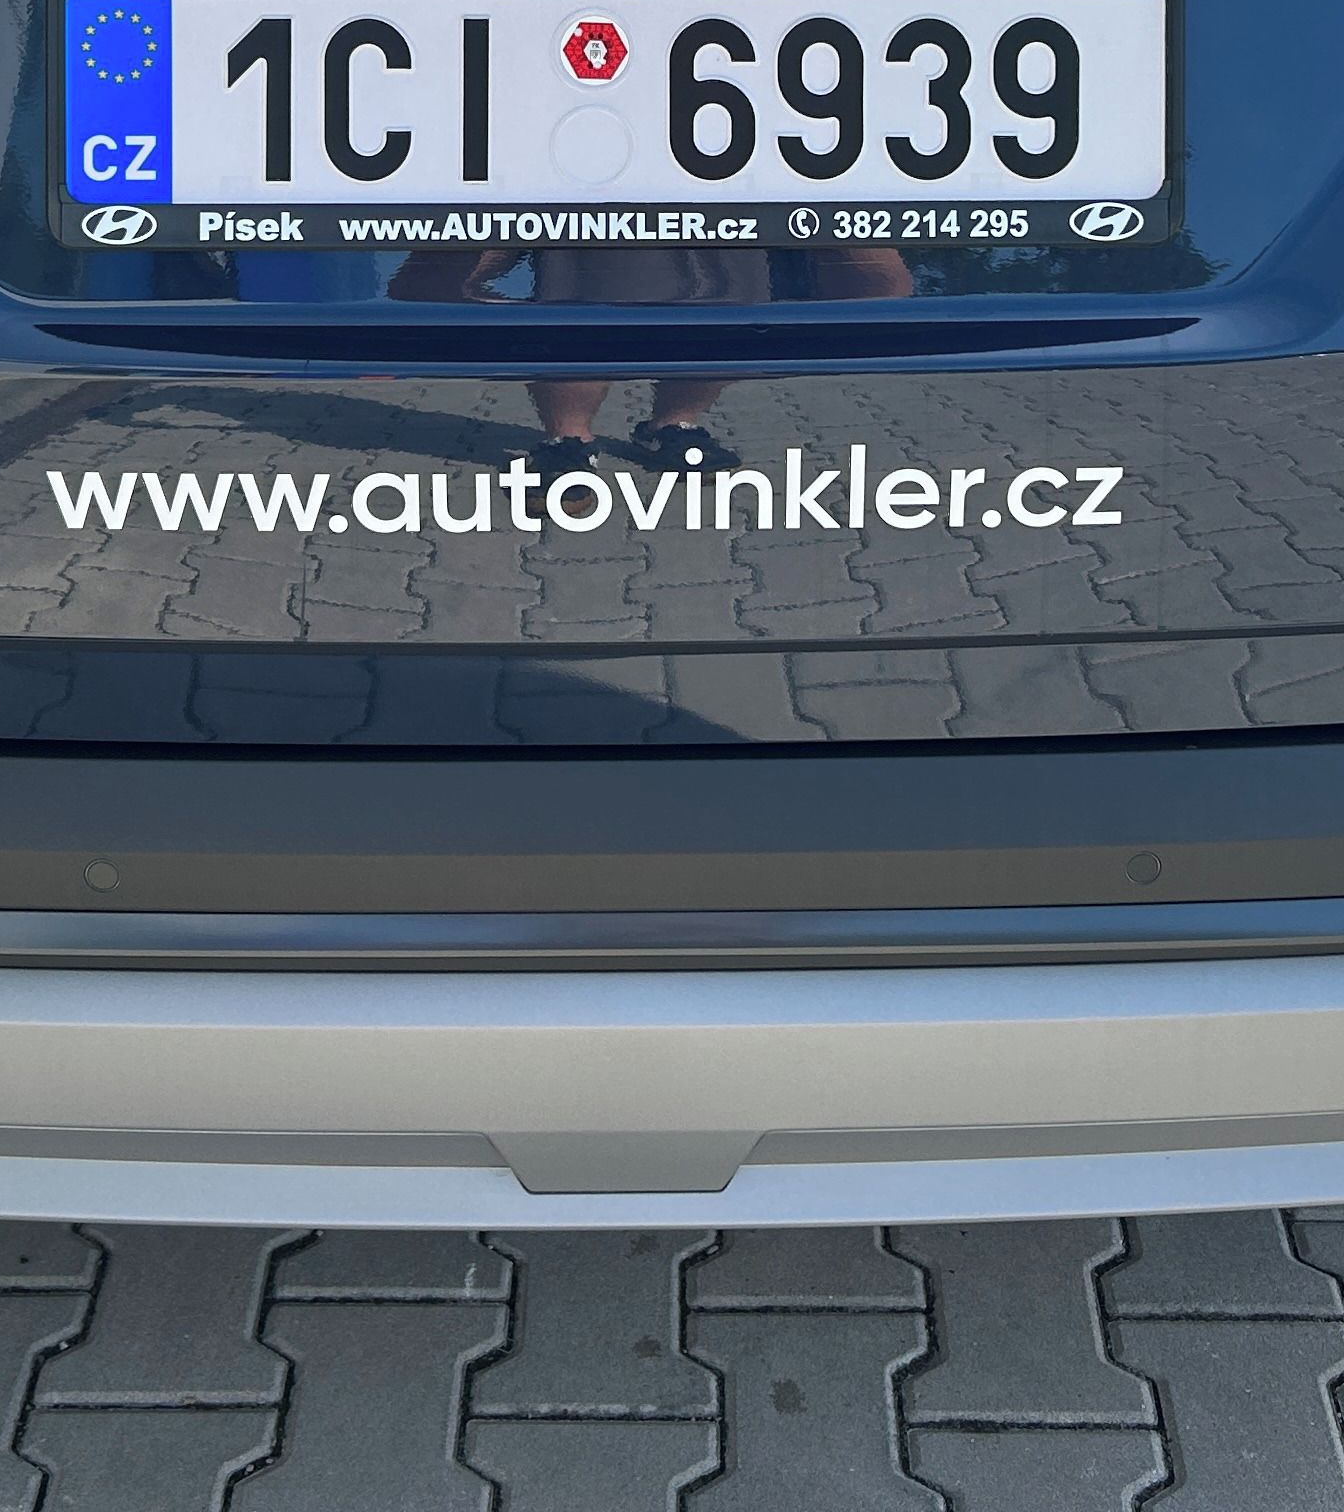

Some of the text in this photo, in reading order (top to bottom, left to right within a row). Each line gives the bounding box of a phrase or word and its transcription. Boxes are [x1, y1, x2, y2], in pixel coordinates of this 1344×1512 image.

[227, 17, 1080, 182] 1CI 6939
[83, 134, 157, 181] CZ
[199, 209, 1029, 241] Písek www.AUTOVINKLER.cz 382 214 295
[46, 444, 1124, 534] www.autovinkler.cz
